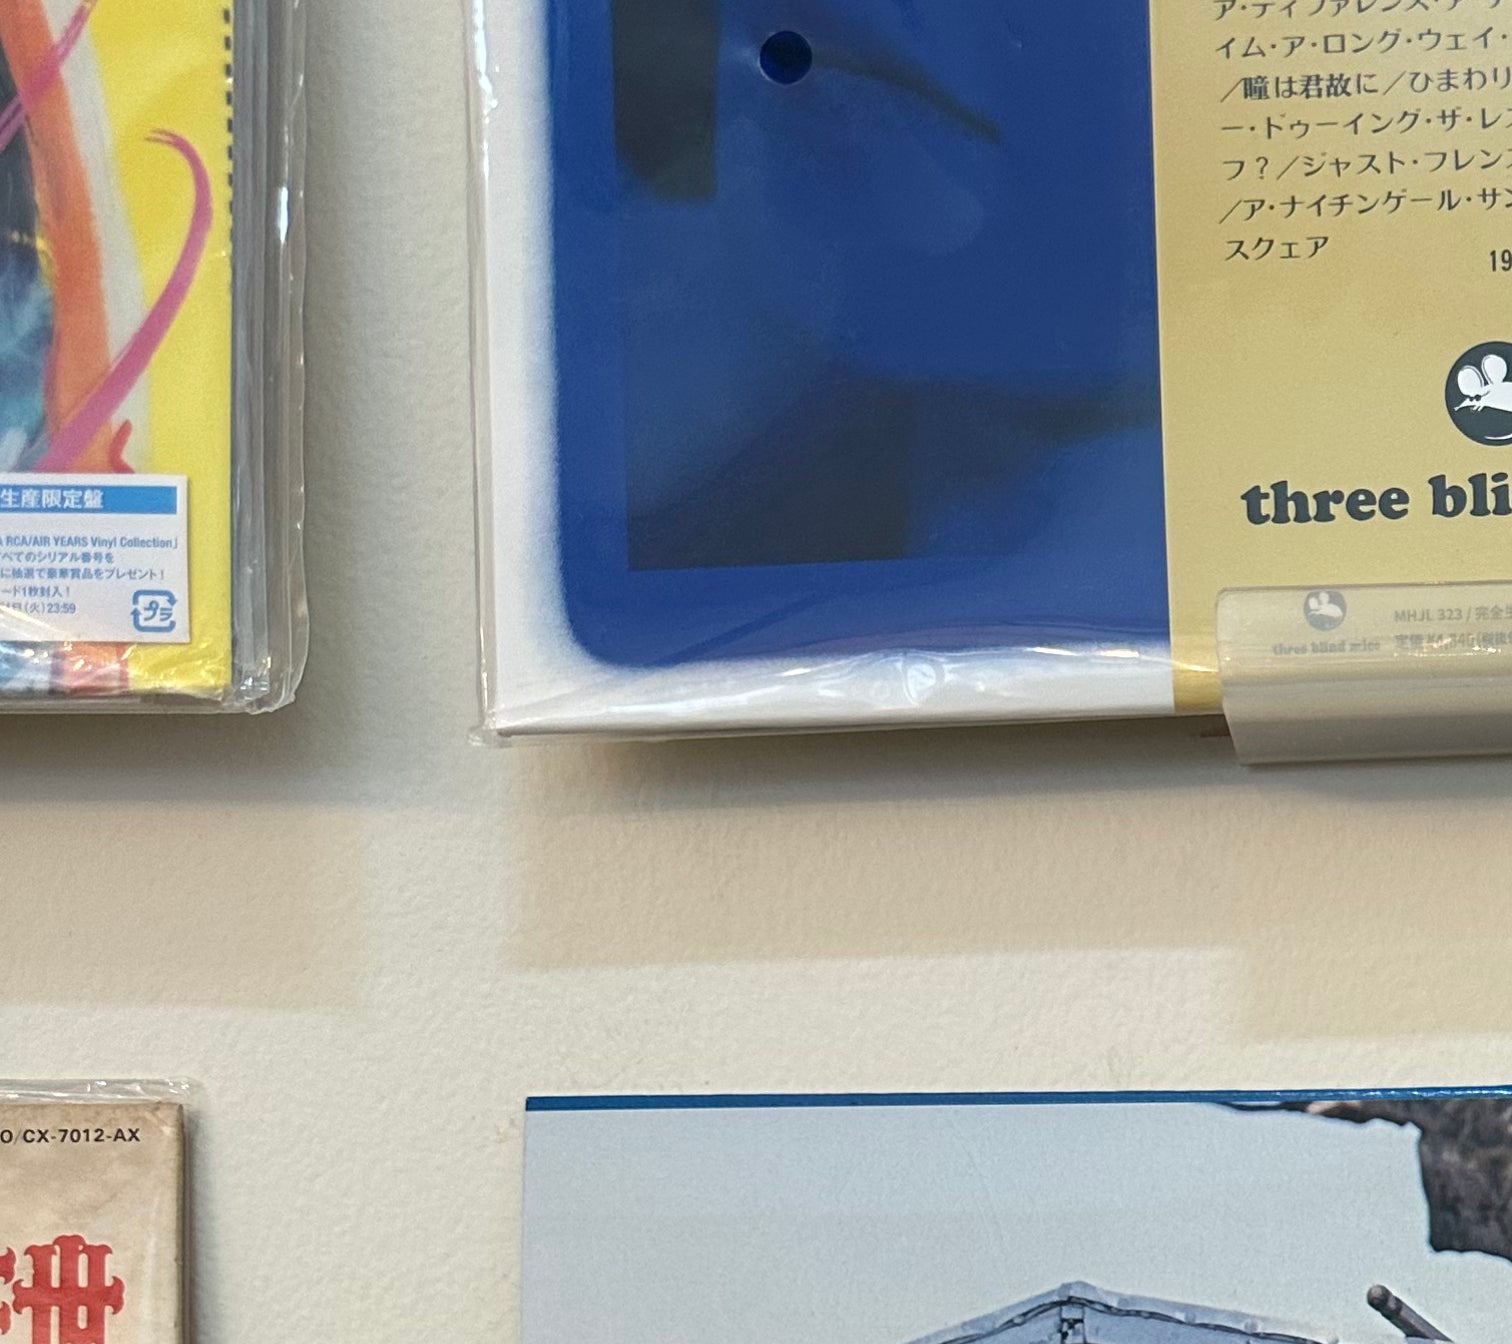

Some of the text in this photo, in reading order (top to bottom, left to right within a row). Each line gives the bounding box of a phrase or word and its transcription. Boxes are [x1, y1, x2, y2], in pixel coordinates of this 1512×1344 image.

[1225, 236, 1329, 262] スクェア
[1241, 479, 1410, 526] three
[6, 535, 51, 548] RCA/AIR
[53, 535, 88, 549] YEARS
[90, 536, 118, 550] Vinyl
